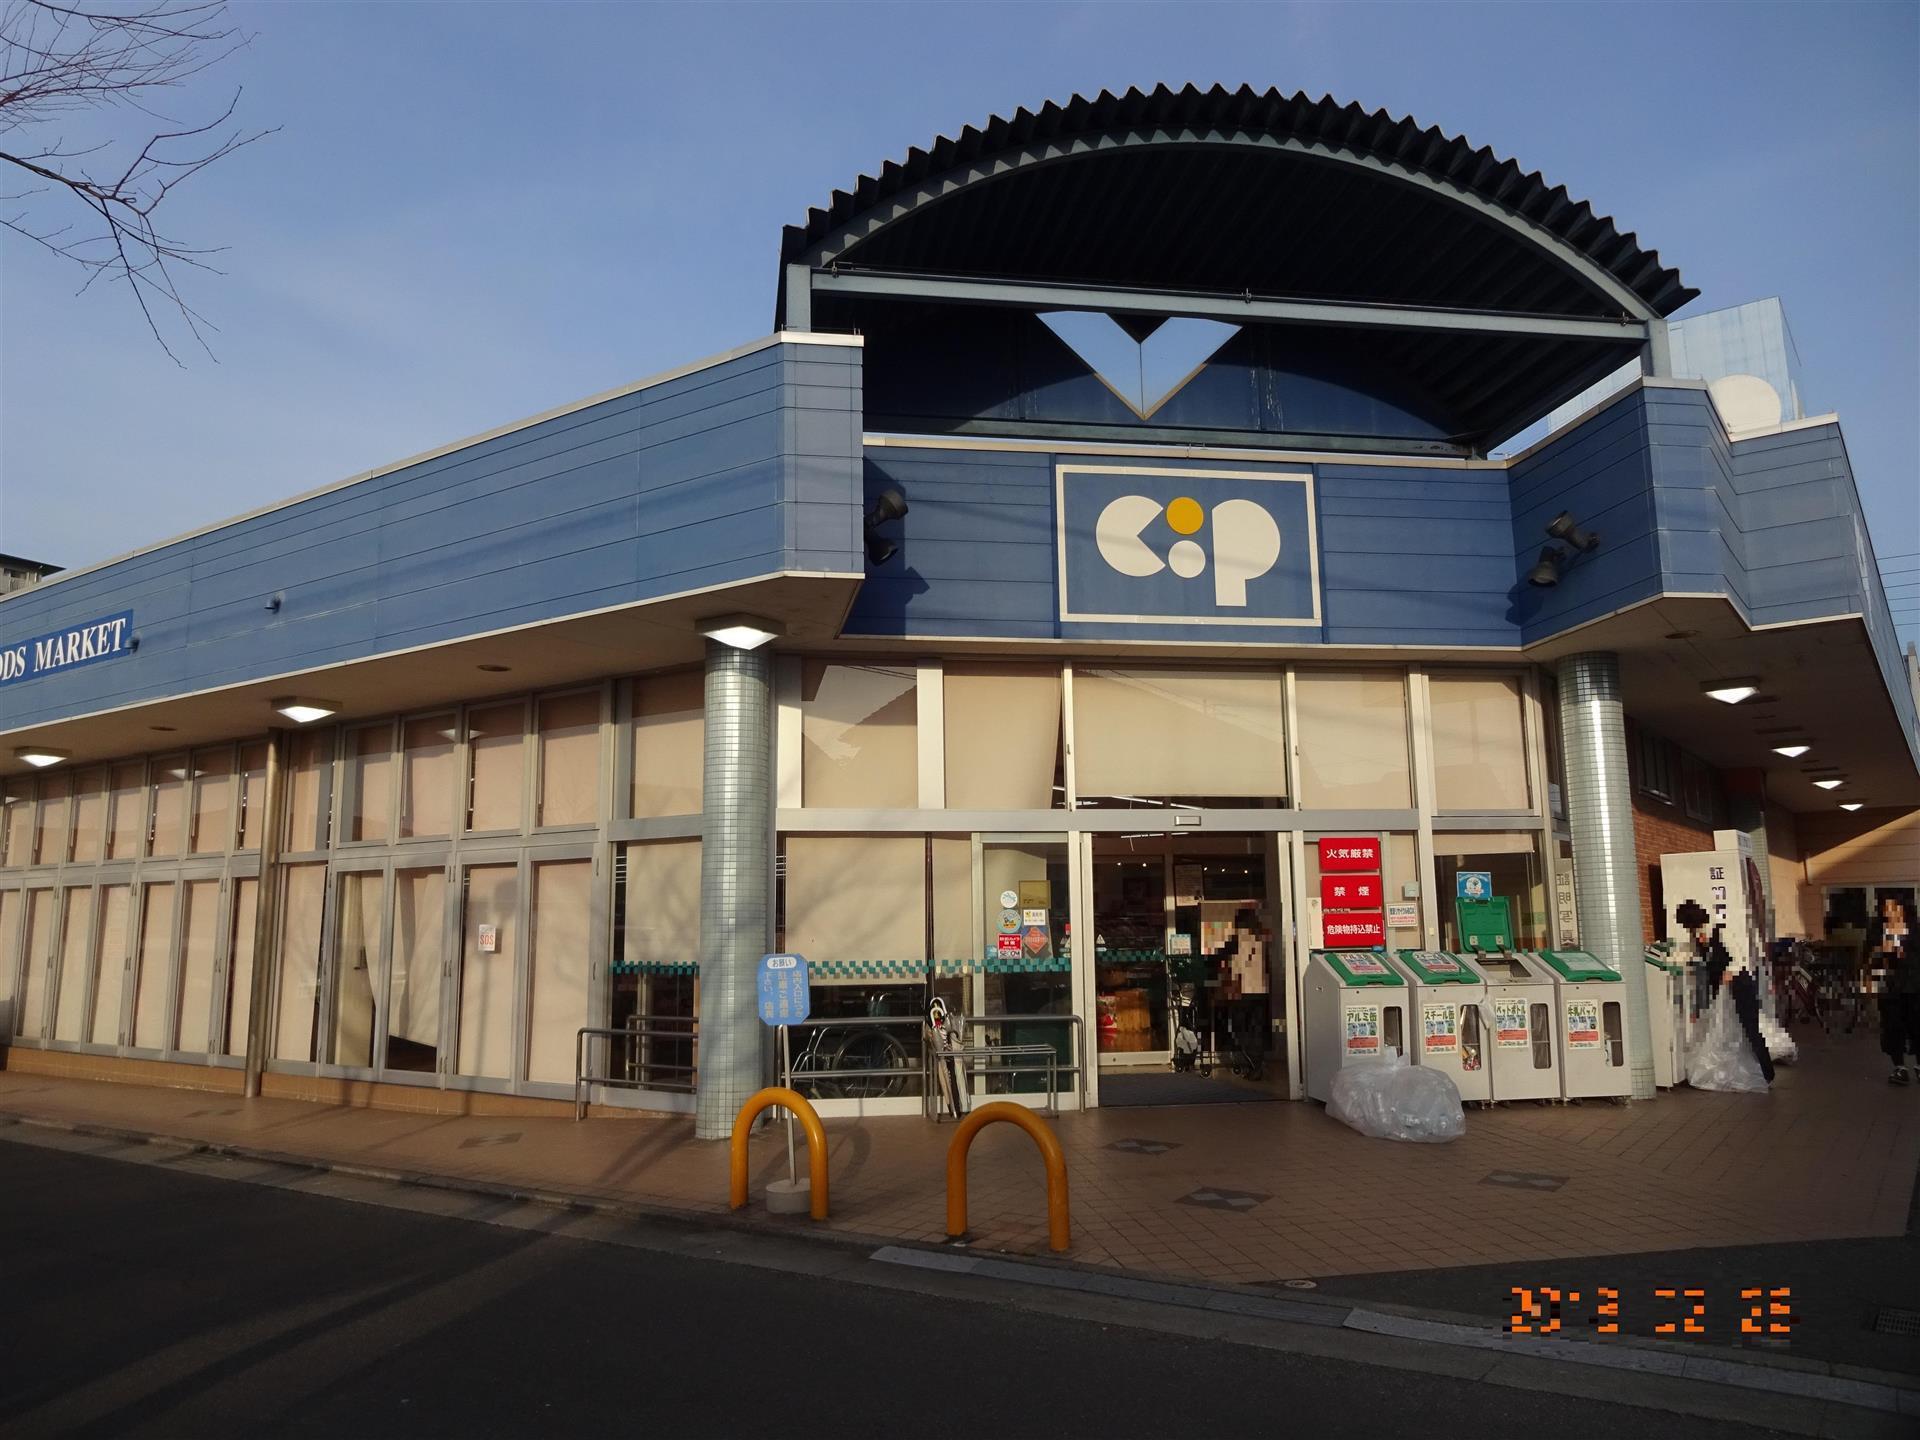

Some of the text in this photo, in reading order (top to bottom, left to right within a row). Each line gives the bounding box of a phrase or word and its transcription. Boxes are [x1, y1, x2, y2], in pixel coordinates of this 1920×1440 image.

[0, 618, 126, 681] DS MARKET
[1326, 848, 1374, 859] 火気厳禁
[1333, 886, 1370, 896] 禁煙
[1327, 924, 1381, 935] 危険物持込禁止
[480, 934, 494, 945] SOS
[1347, 1012, 1377, 1022] アルミ缶
